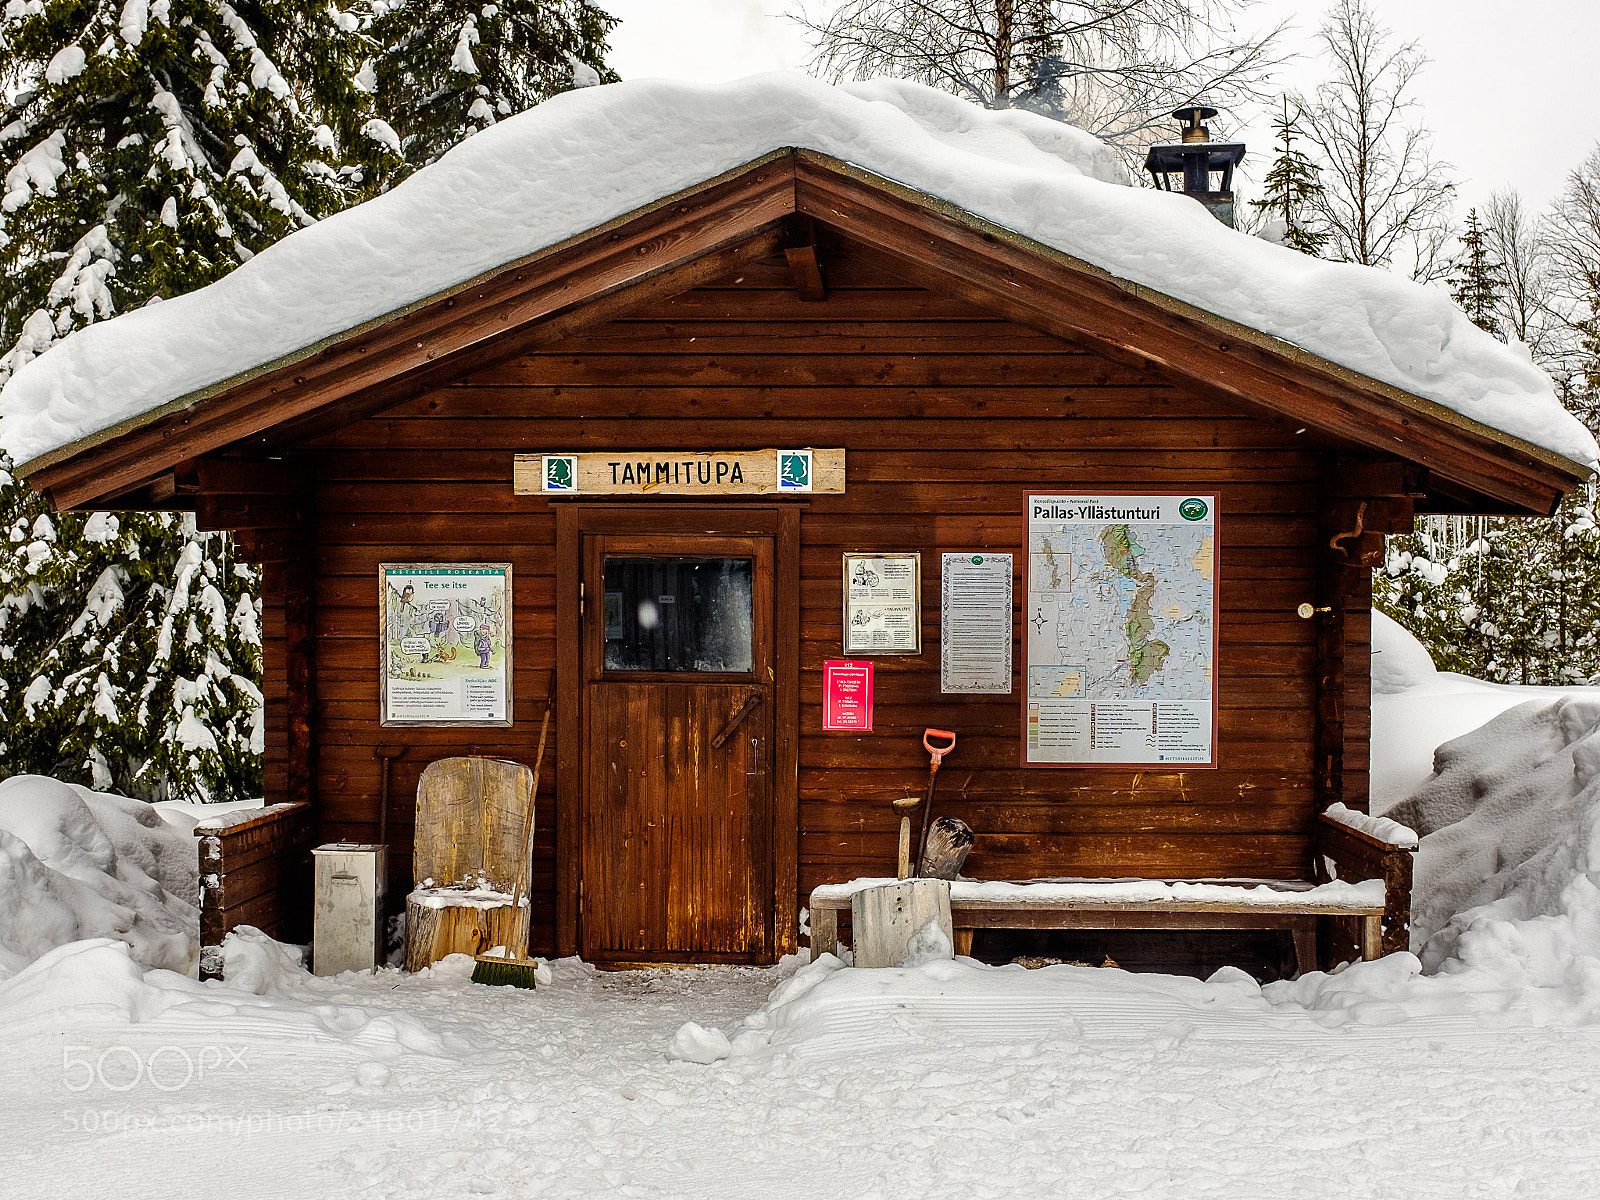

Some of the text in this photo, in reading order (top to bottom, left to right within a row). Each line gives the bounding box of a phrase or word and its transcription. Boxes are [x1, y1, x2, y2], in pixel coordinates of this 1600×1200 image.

[607, 461, 744, 485] TAMMITUPA
[1033, 506, 1160, 520] Pallas-Yllästunturi
[424, 581, 439, 589] Tee
[452, 581, 467, 589] itse
